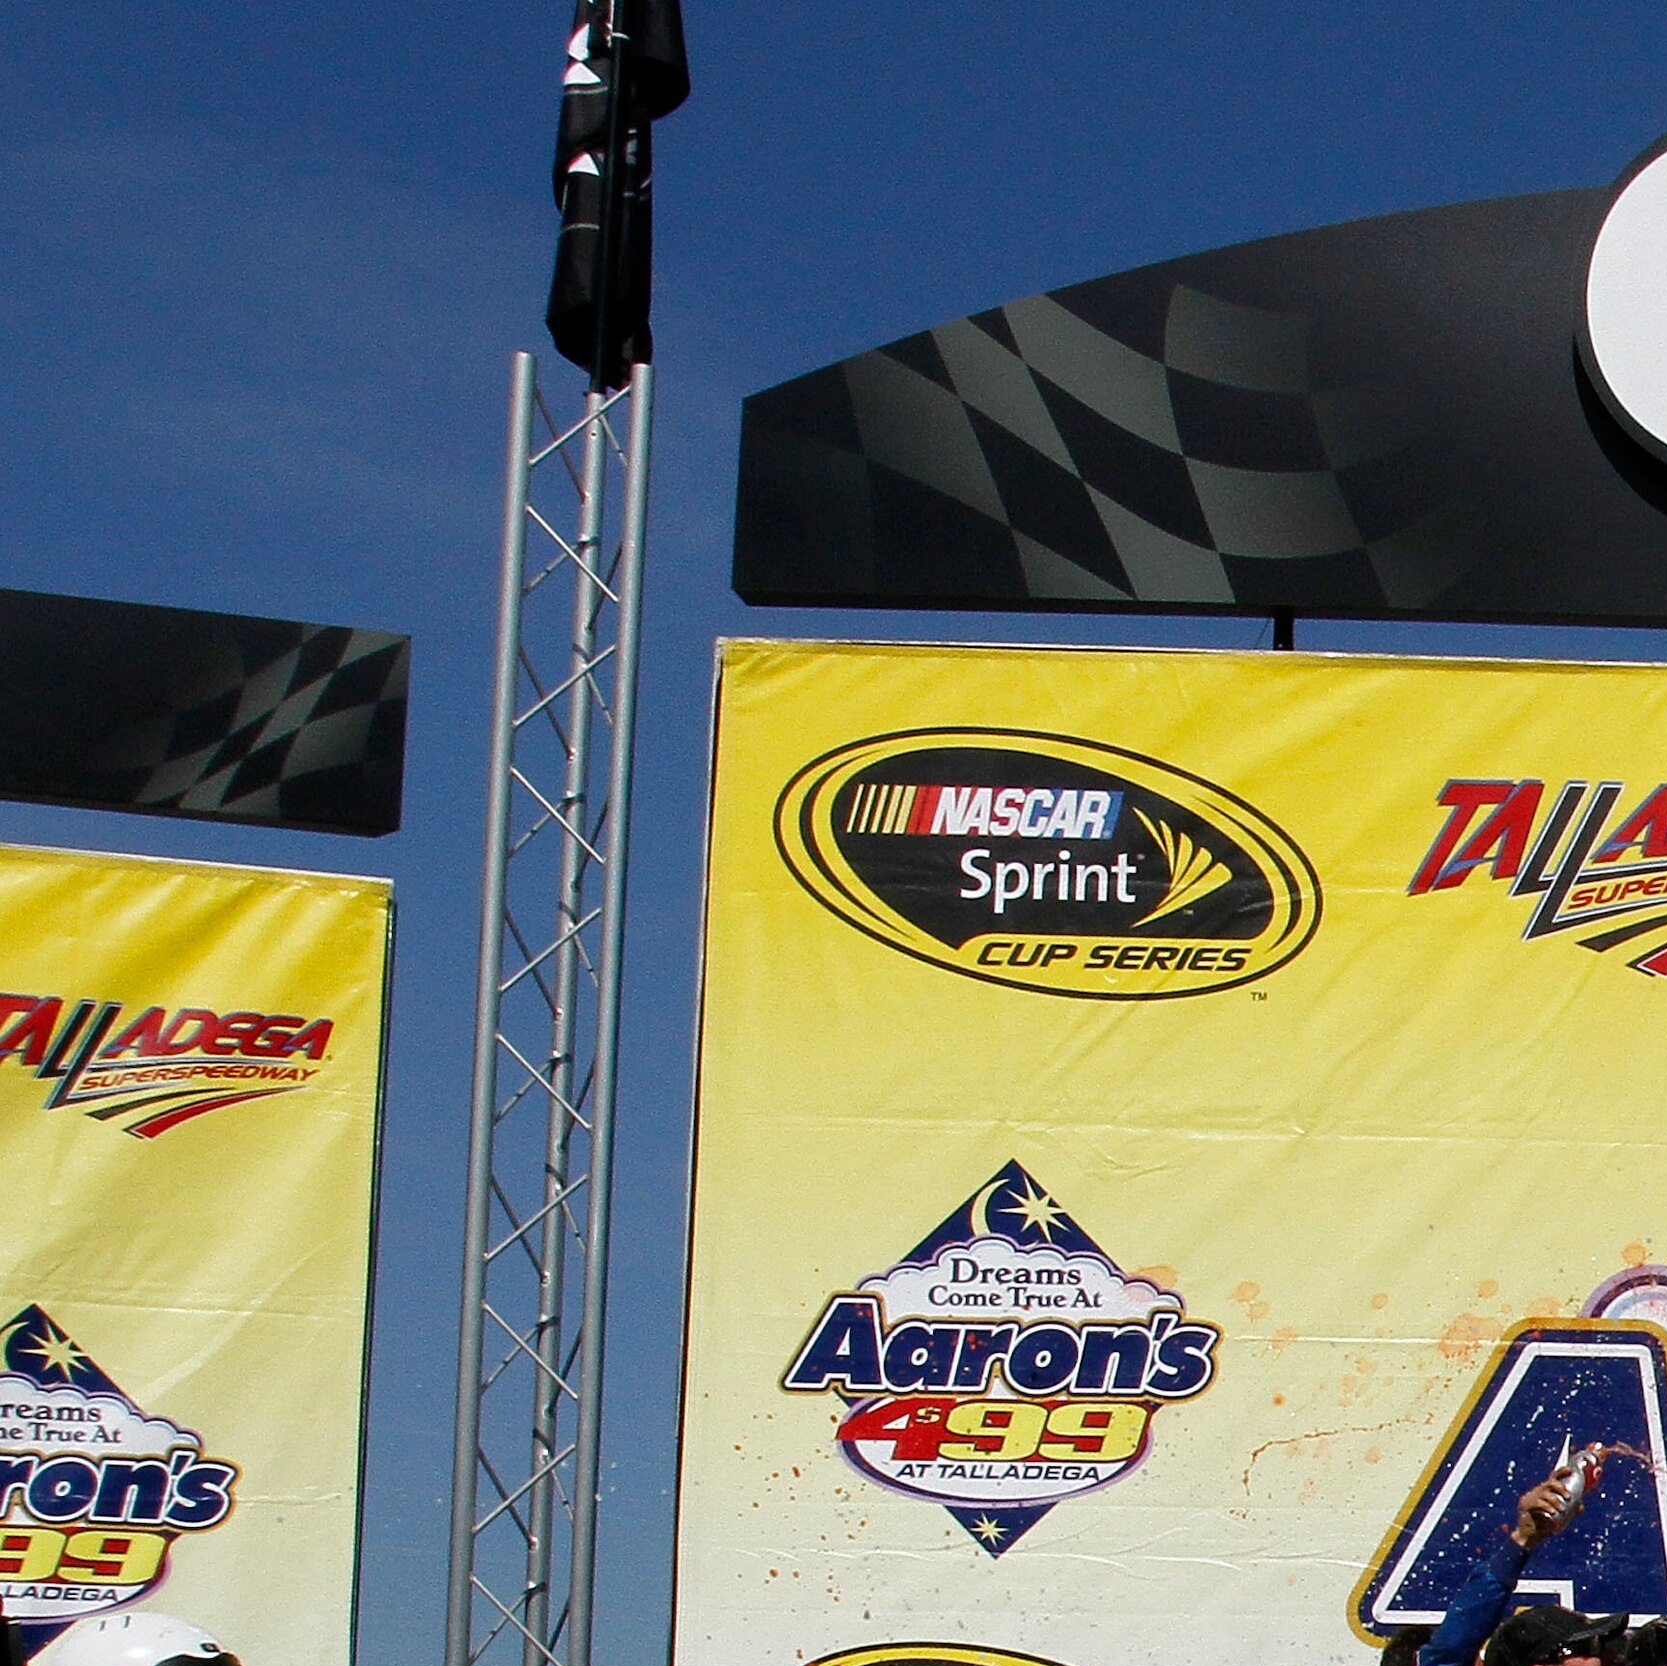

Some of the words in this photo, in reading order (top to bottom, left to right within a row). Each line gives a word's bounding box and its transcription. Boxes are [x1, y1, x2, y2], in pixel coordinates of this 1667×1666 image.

[930, 786, 1112, 838] NASCAR
[959, 849, 1136, 912] Sprint
[976, 942, 1077, 969] CUP
[1084, 945, 1252, 972] SERIES
[81, 1065, 320, 1091] SUPERSPEEDWAY
[951, 1259, 1081, 1286] Dreams
[928, 1286, 1001, 1308] Come
[1008, 1287, 1067, 1308] True
[1070, 1288, 1102, 1308] At
[783, 1296, 1218, 1396] Aaron's
[31, 1423, 84, 1442] True
[92, 1424, 121, 1443] At
[897, 1465, 933, 1478] AT
[938, 1464, 1099, 1481] TALLADEGA
